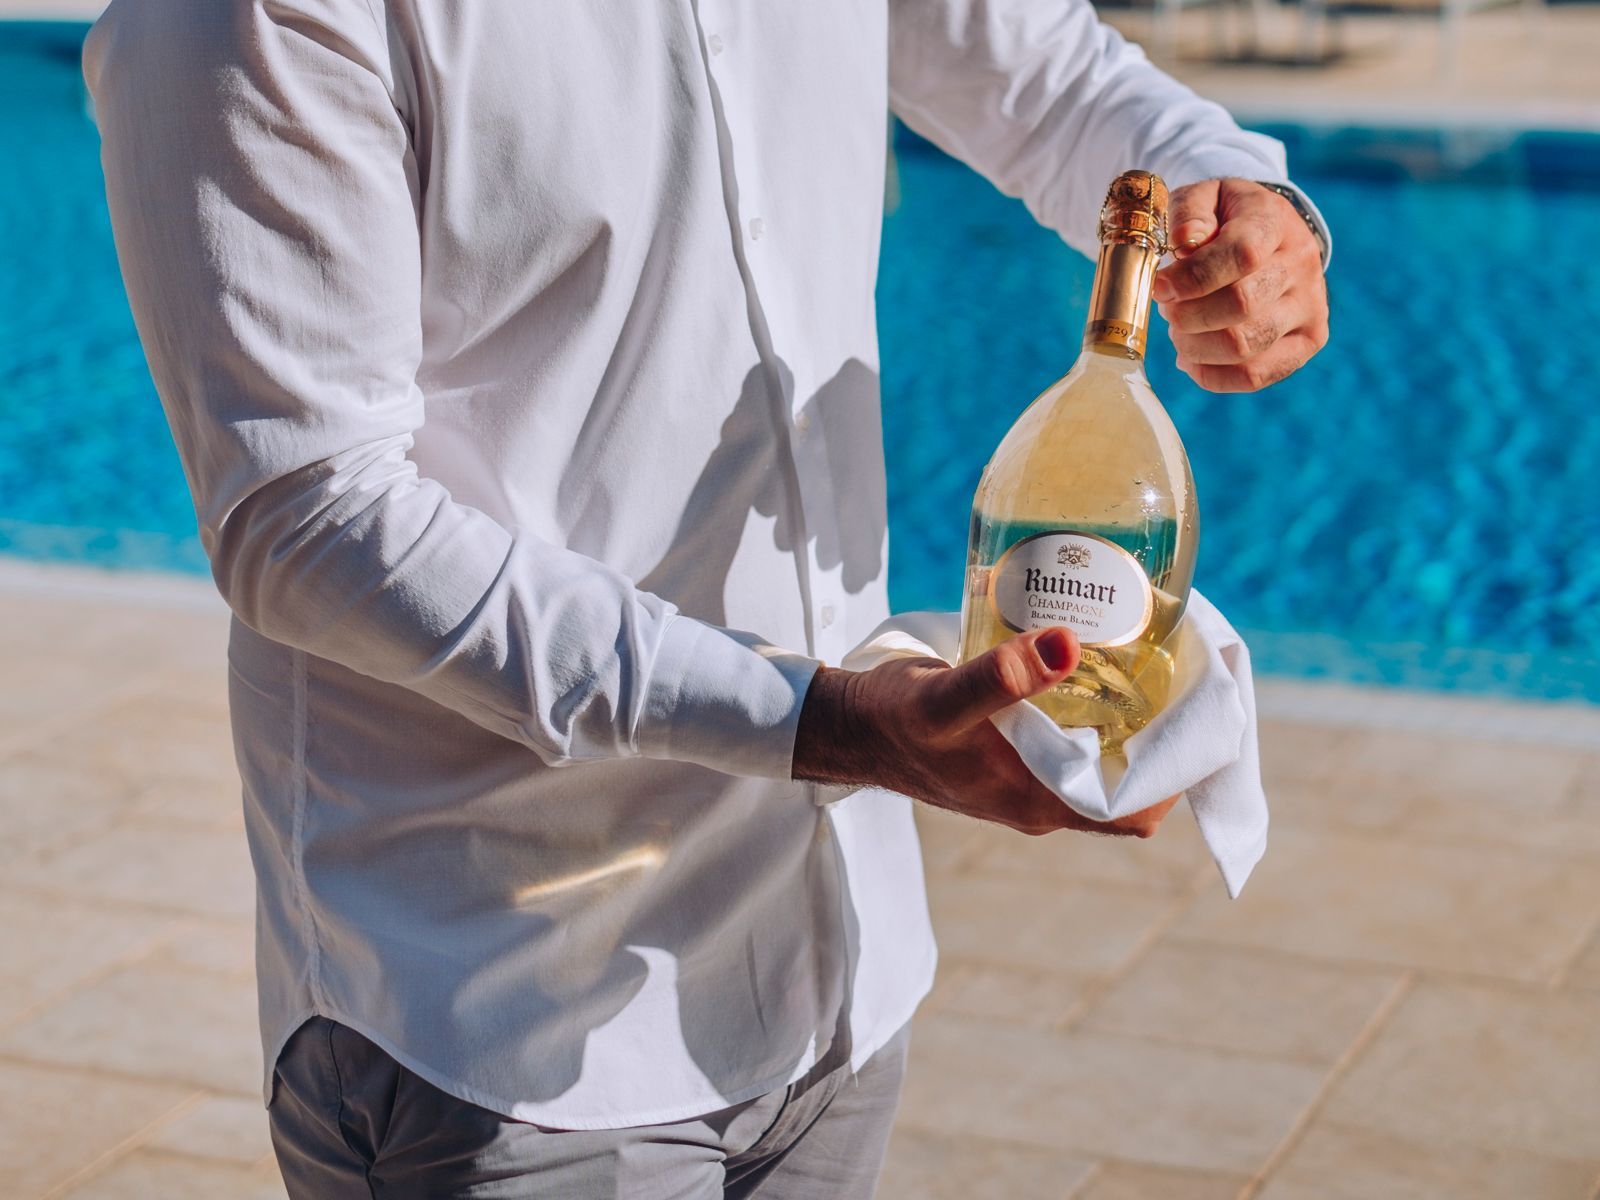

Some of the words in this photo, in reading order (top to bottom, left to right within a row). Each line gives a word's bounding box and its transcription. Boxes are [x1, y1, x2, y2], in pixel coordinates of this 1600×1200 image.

[1103, 325, 1128, 338] 1729
[1025, 567, 1116, 604] Ruinart
[1028, 594, 1105, 618] CHAMPAGNE
[1031, 610, 1057, 620] BLANC
[1070, 615, 1099, 629] BLANCS
